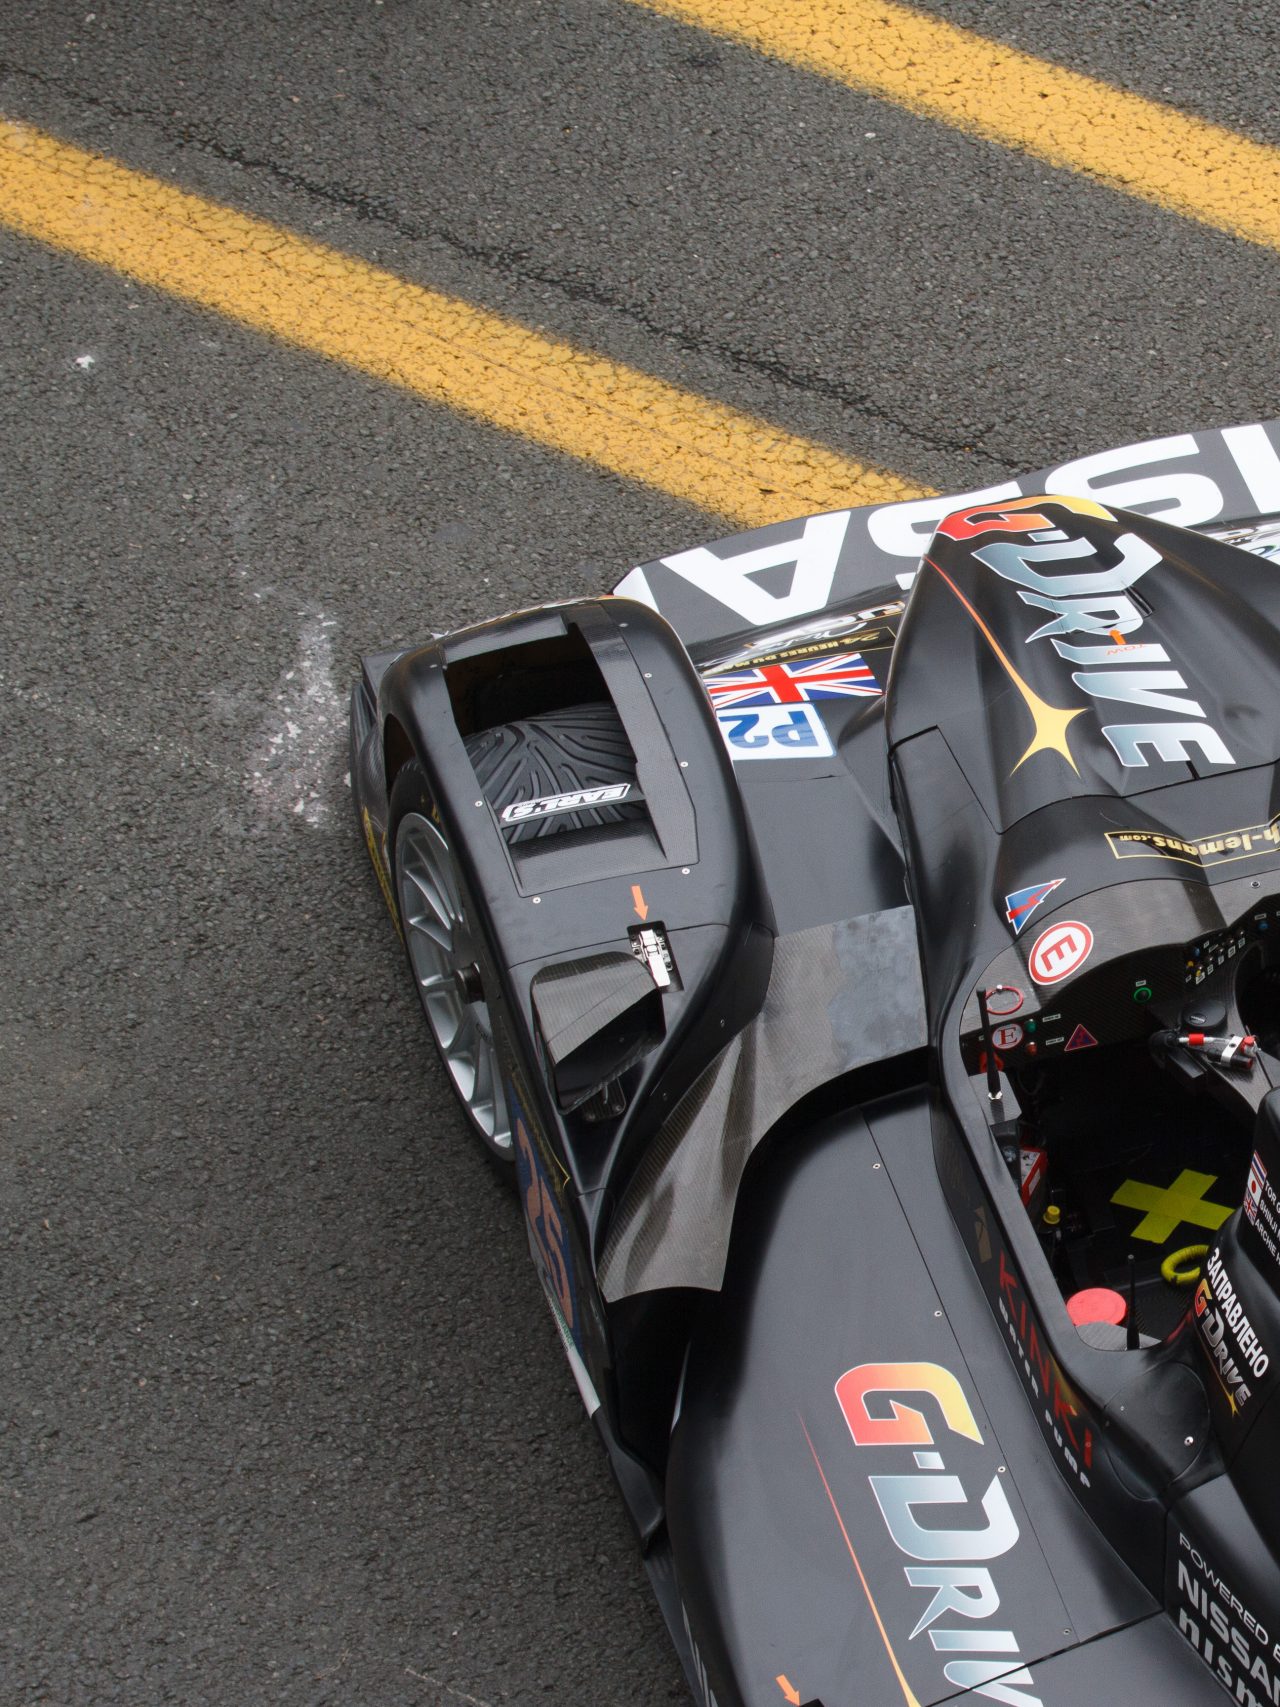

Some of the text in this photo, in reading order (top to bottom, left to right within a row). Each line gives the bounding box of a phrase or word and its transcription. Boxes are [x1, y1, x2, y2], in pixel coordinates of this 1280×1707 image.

[937, 494, 1236, 768] G-DRIVE
[716, 710, 820, 750] P2
[512, 785, 626, 819] EARL'S
[1040, 934, 1078, 972] E
[999, 1026, 1018, 1046] E
[1259, 1199, 1278, 1232] SHINJI
[1264, 1179, 1277, 1206] TOR
[1254, 1218, 1277, 1257] ARCHIE
[1195, 1278, 1252, 1407] G-DRIVE
[1206, 1247, 1271, 1379] ЗАПРАВЛЕНО
[1000, 1251, 1092, 1469] KINKI
[834, 1362, 1044, 1707] G-DRIV
[1179, 1532, 1270, 1646] POWERED
[1179, 1607, 1264, 1707] nism
